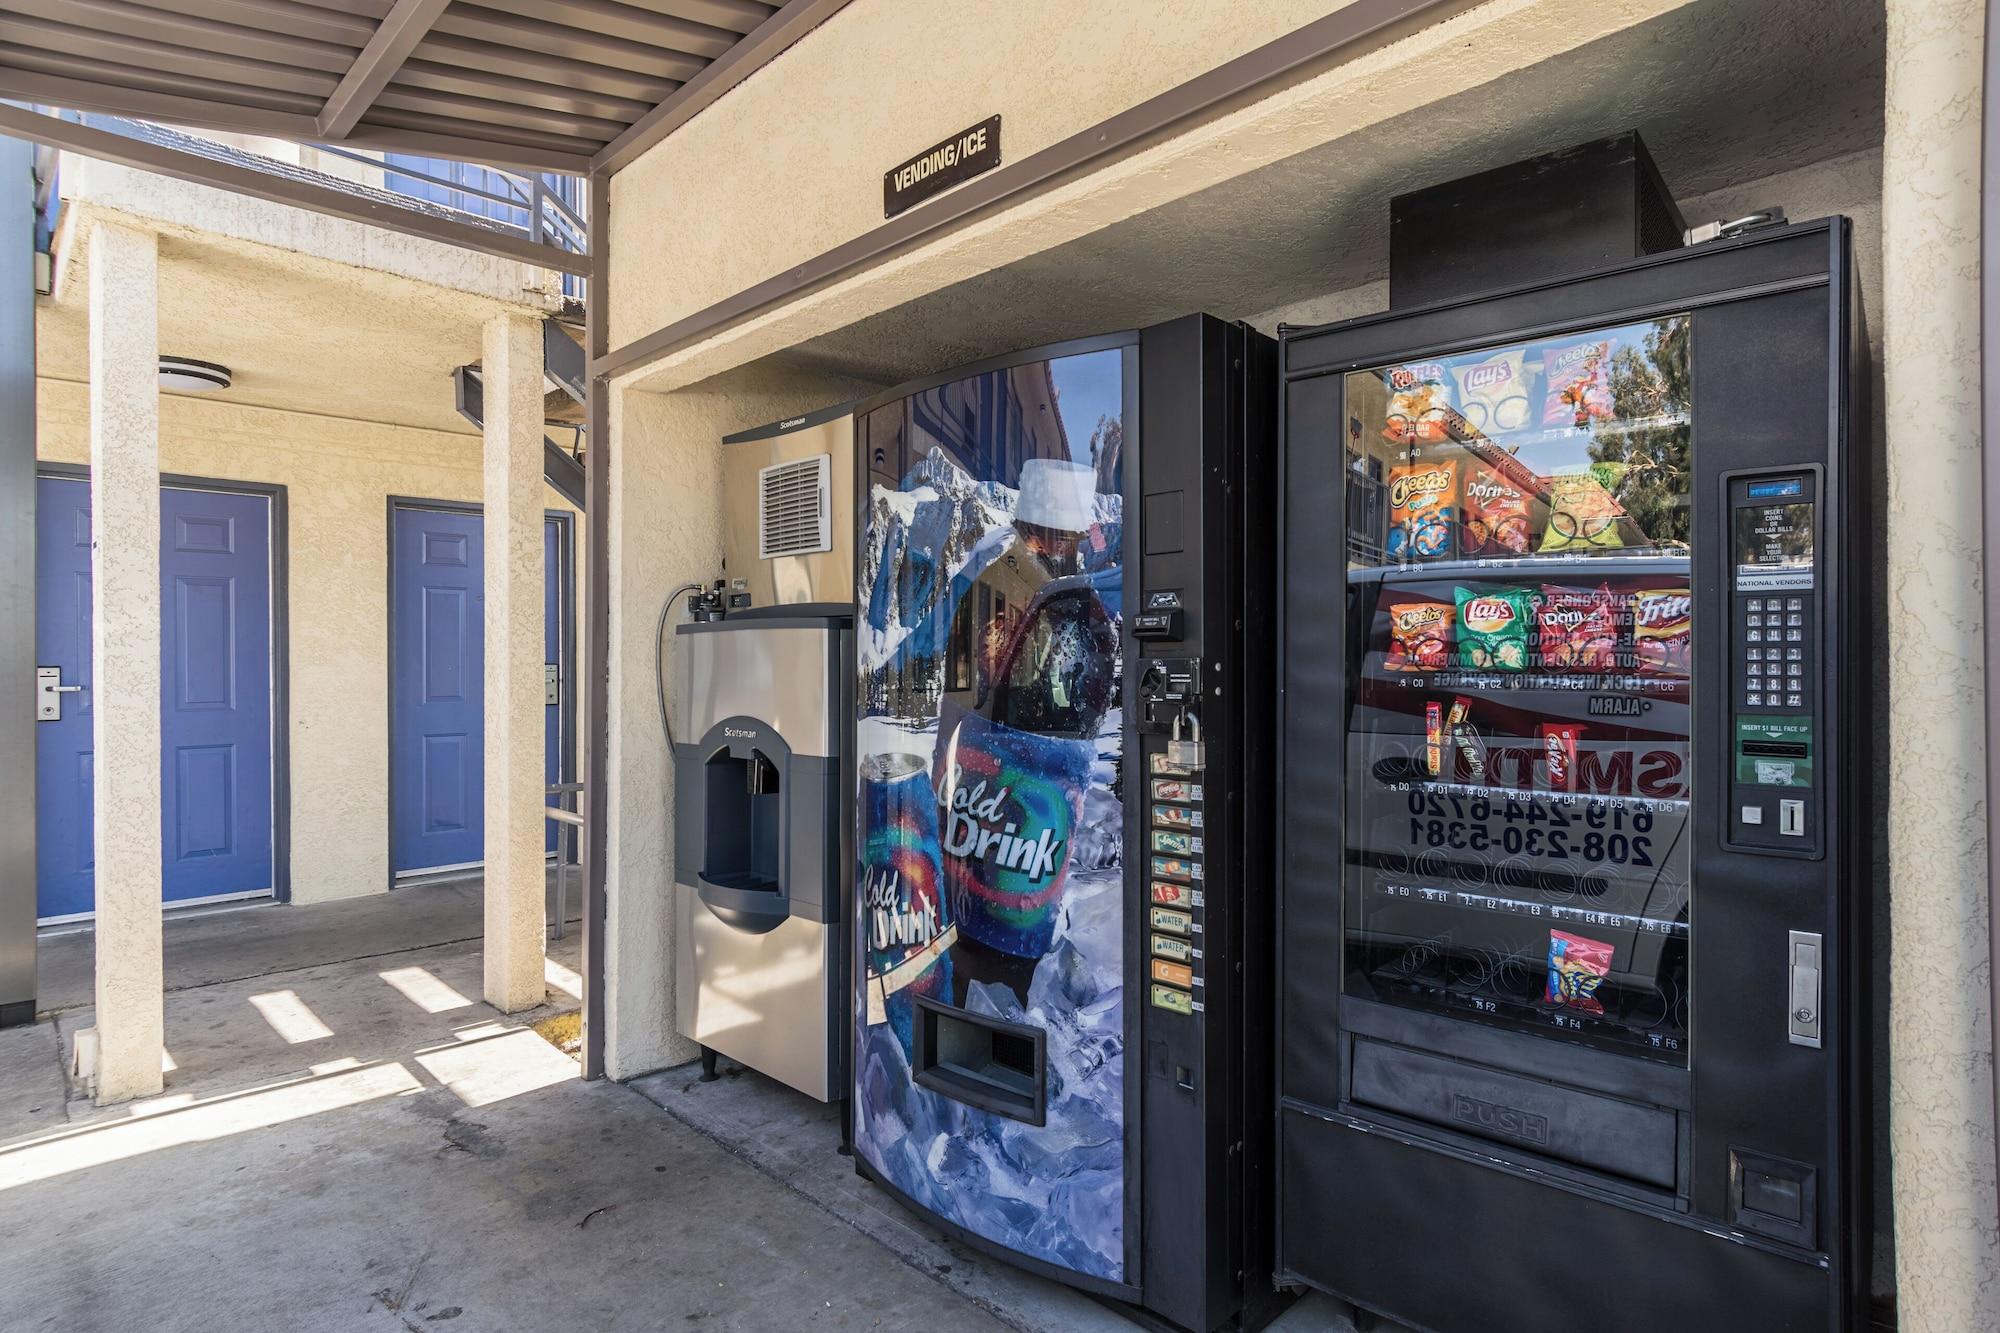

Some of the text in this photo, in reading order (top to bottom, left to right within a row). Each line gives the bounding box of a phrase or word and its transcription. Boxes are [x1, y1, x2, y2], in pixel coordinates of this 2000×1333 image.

[894, 127, 987, 193] VENDING/ICE
[779, 417, 806, 430] Scotsman
[1390, 471, 1452, 509] Cheetos
[1763, 508, 1784, 516] INSERT
[1737, 578, 1812, 587] NATIONAL VENDORS
[1750, 600, 1758, 610] A
[1791, 599, 1798, 608] C
[1751, 614, 1798, 625] D E F
[1751, 630, 1758, 640] G
[1771, 630, 1778, 639] H
[1751, 649, 1797, 659] 1 2 3
[1751, 664, 1797, 673] 4 5 6
[1412, 679, 1424, 688] C0
[1490, 680, 1502, 689] C2
[1571, 680, 1584, 691] C4
[1660, 681, 1675, 692] C6
[1751, 679, 1797, 689] 7 8 9
[1770, 694, 1777, 704] 0
[724, 727, 756, 739] Scotsman
[1398, 782, 1410, 791] D0
[1437, 785, 1448, 795] D1
[937, 763, 1011, 823] Cold
[1477, 788, 1489, 798] D2
[1520, 791, 1532, 801] D3
[1563, 795, 1576, 805] D4
[1610, 799, 1623, 809] D5
[1659, 803, 1673, 812] D6
[943, 812, 1061, 884] Drink
[863, 863, 899, 909] Cold
[1399, 886, 1410, 897] E0
[1438, 892, 1447, 902] E1
[1487, 899, 1496, 910] E2
[1530, 906, 1541, 915] E3
[873, 897, 937, 950] Drink
[1160, 913, 1183, 927] WATER
[1585, 913, 1595, 923] E4
[1610, 915, 1621, 927] E5
[1660, 923, 1671, 934] E6
[1162, 940, 1184, 953] WATER
[1485, 1001, 1496, 1012] F2
[1569, 1020, 1581, 1030] F4
[1665, 1038, 1678, 1050] F6
[1456, 1099, 1545, 1142] PUSH
